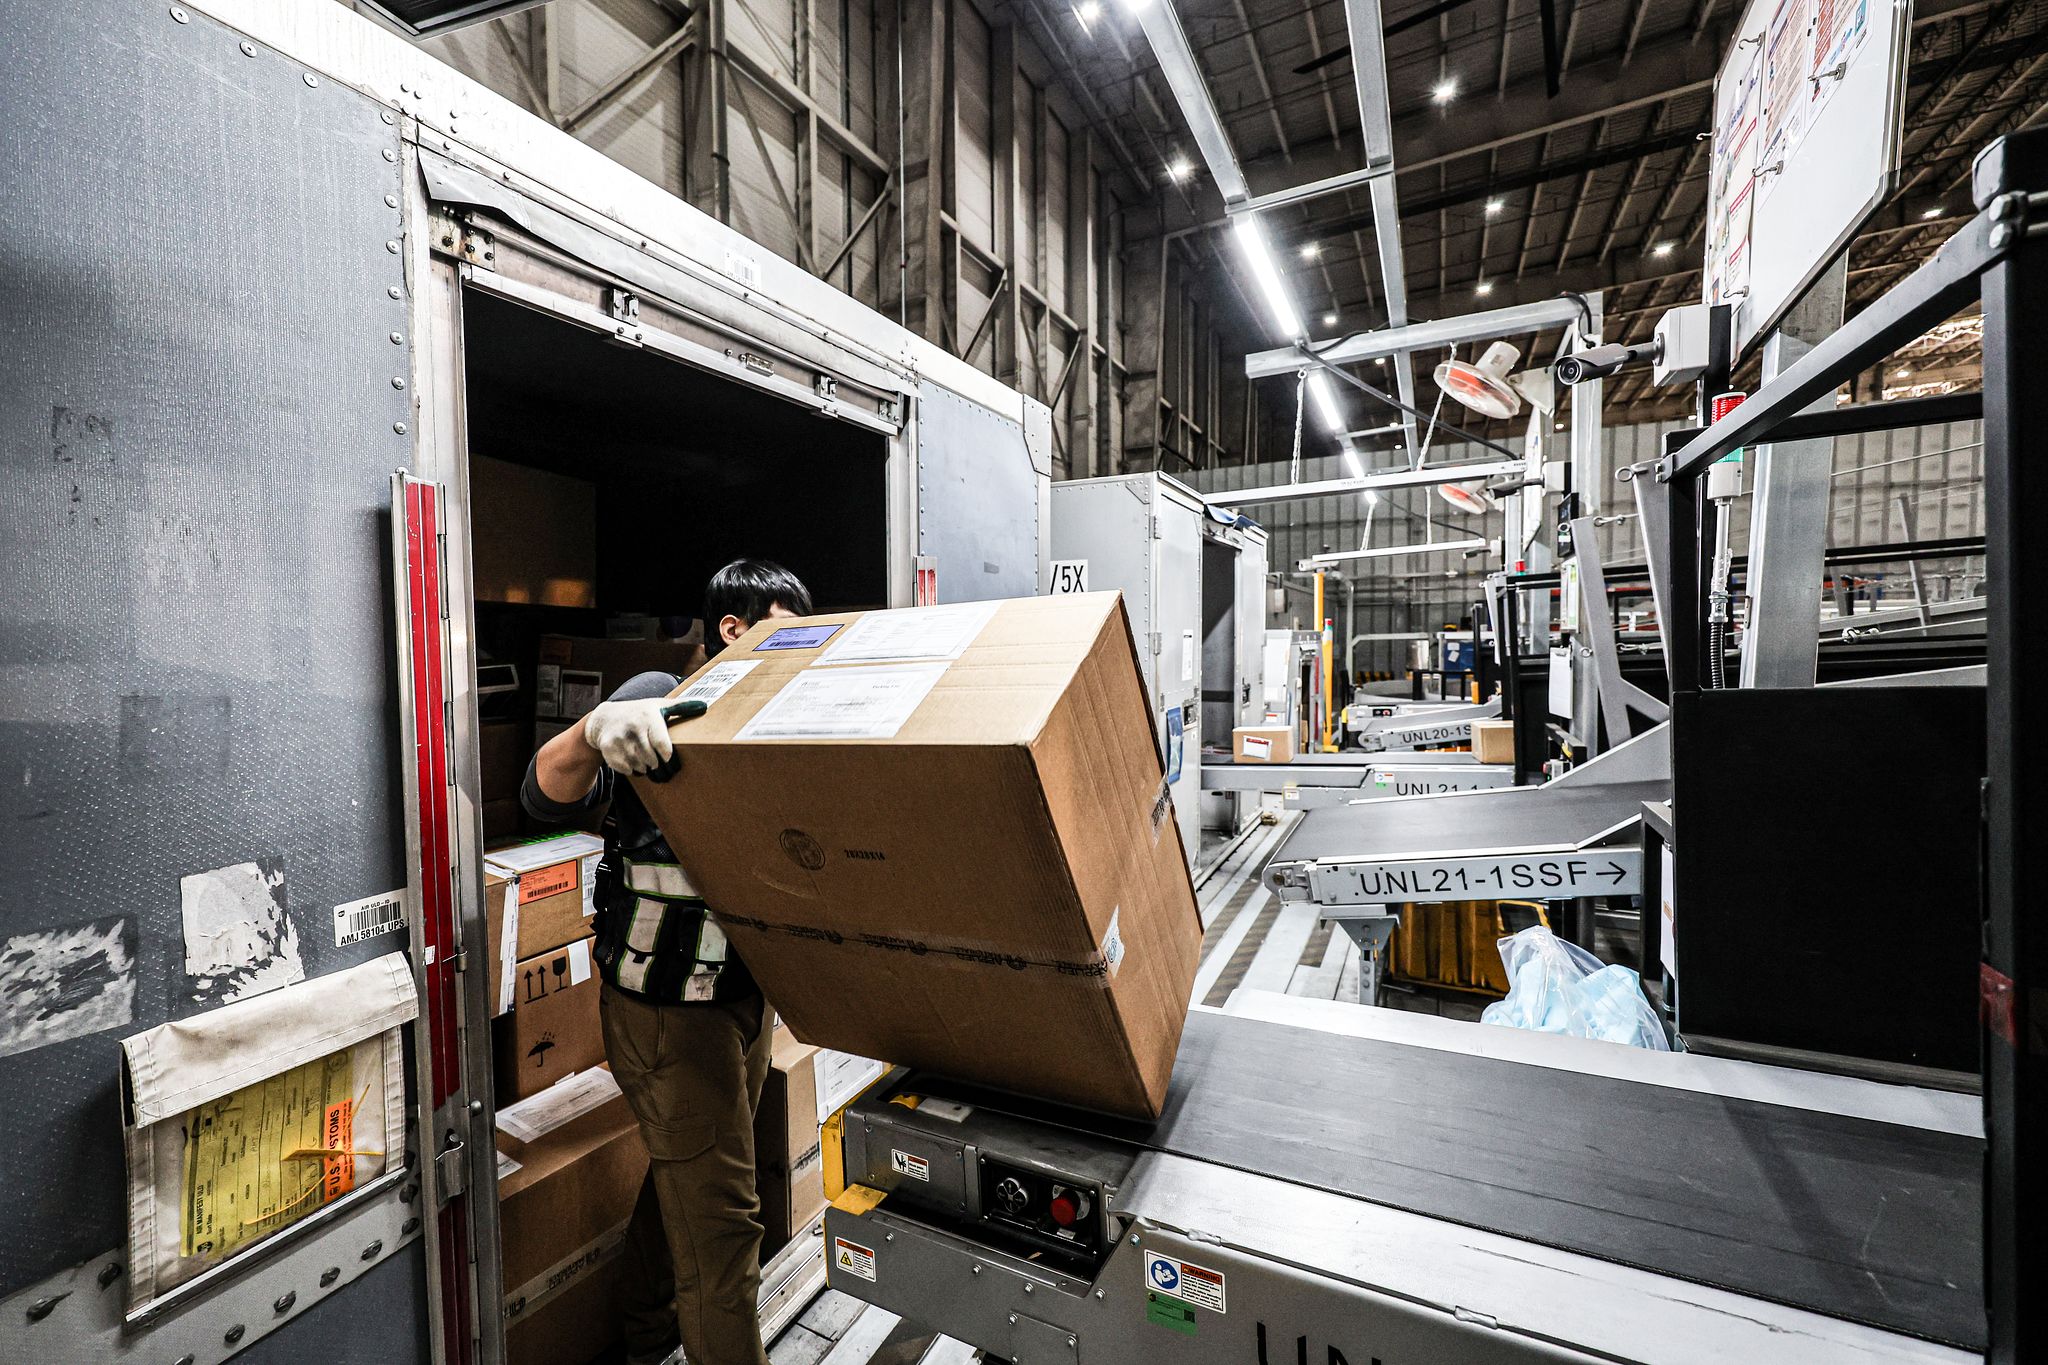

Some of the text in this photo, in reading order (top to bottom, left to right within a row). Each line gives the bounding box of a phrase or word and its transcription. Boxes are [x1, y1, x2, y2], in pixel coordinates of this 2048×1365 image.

[1360, 861, 1587, 895] UNL21-1SSF
[341, 919, 405, 946] AMJ 58104 UPS
[329, 1109, 340, 1161] STOMS
[329, 1162, 340, 1185] U.S.
[196, 1196, 204, 1225] MANIFEST
